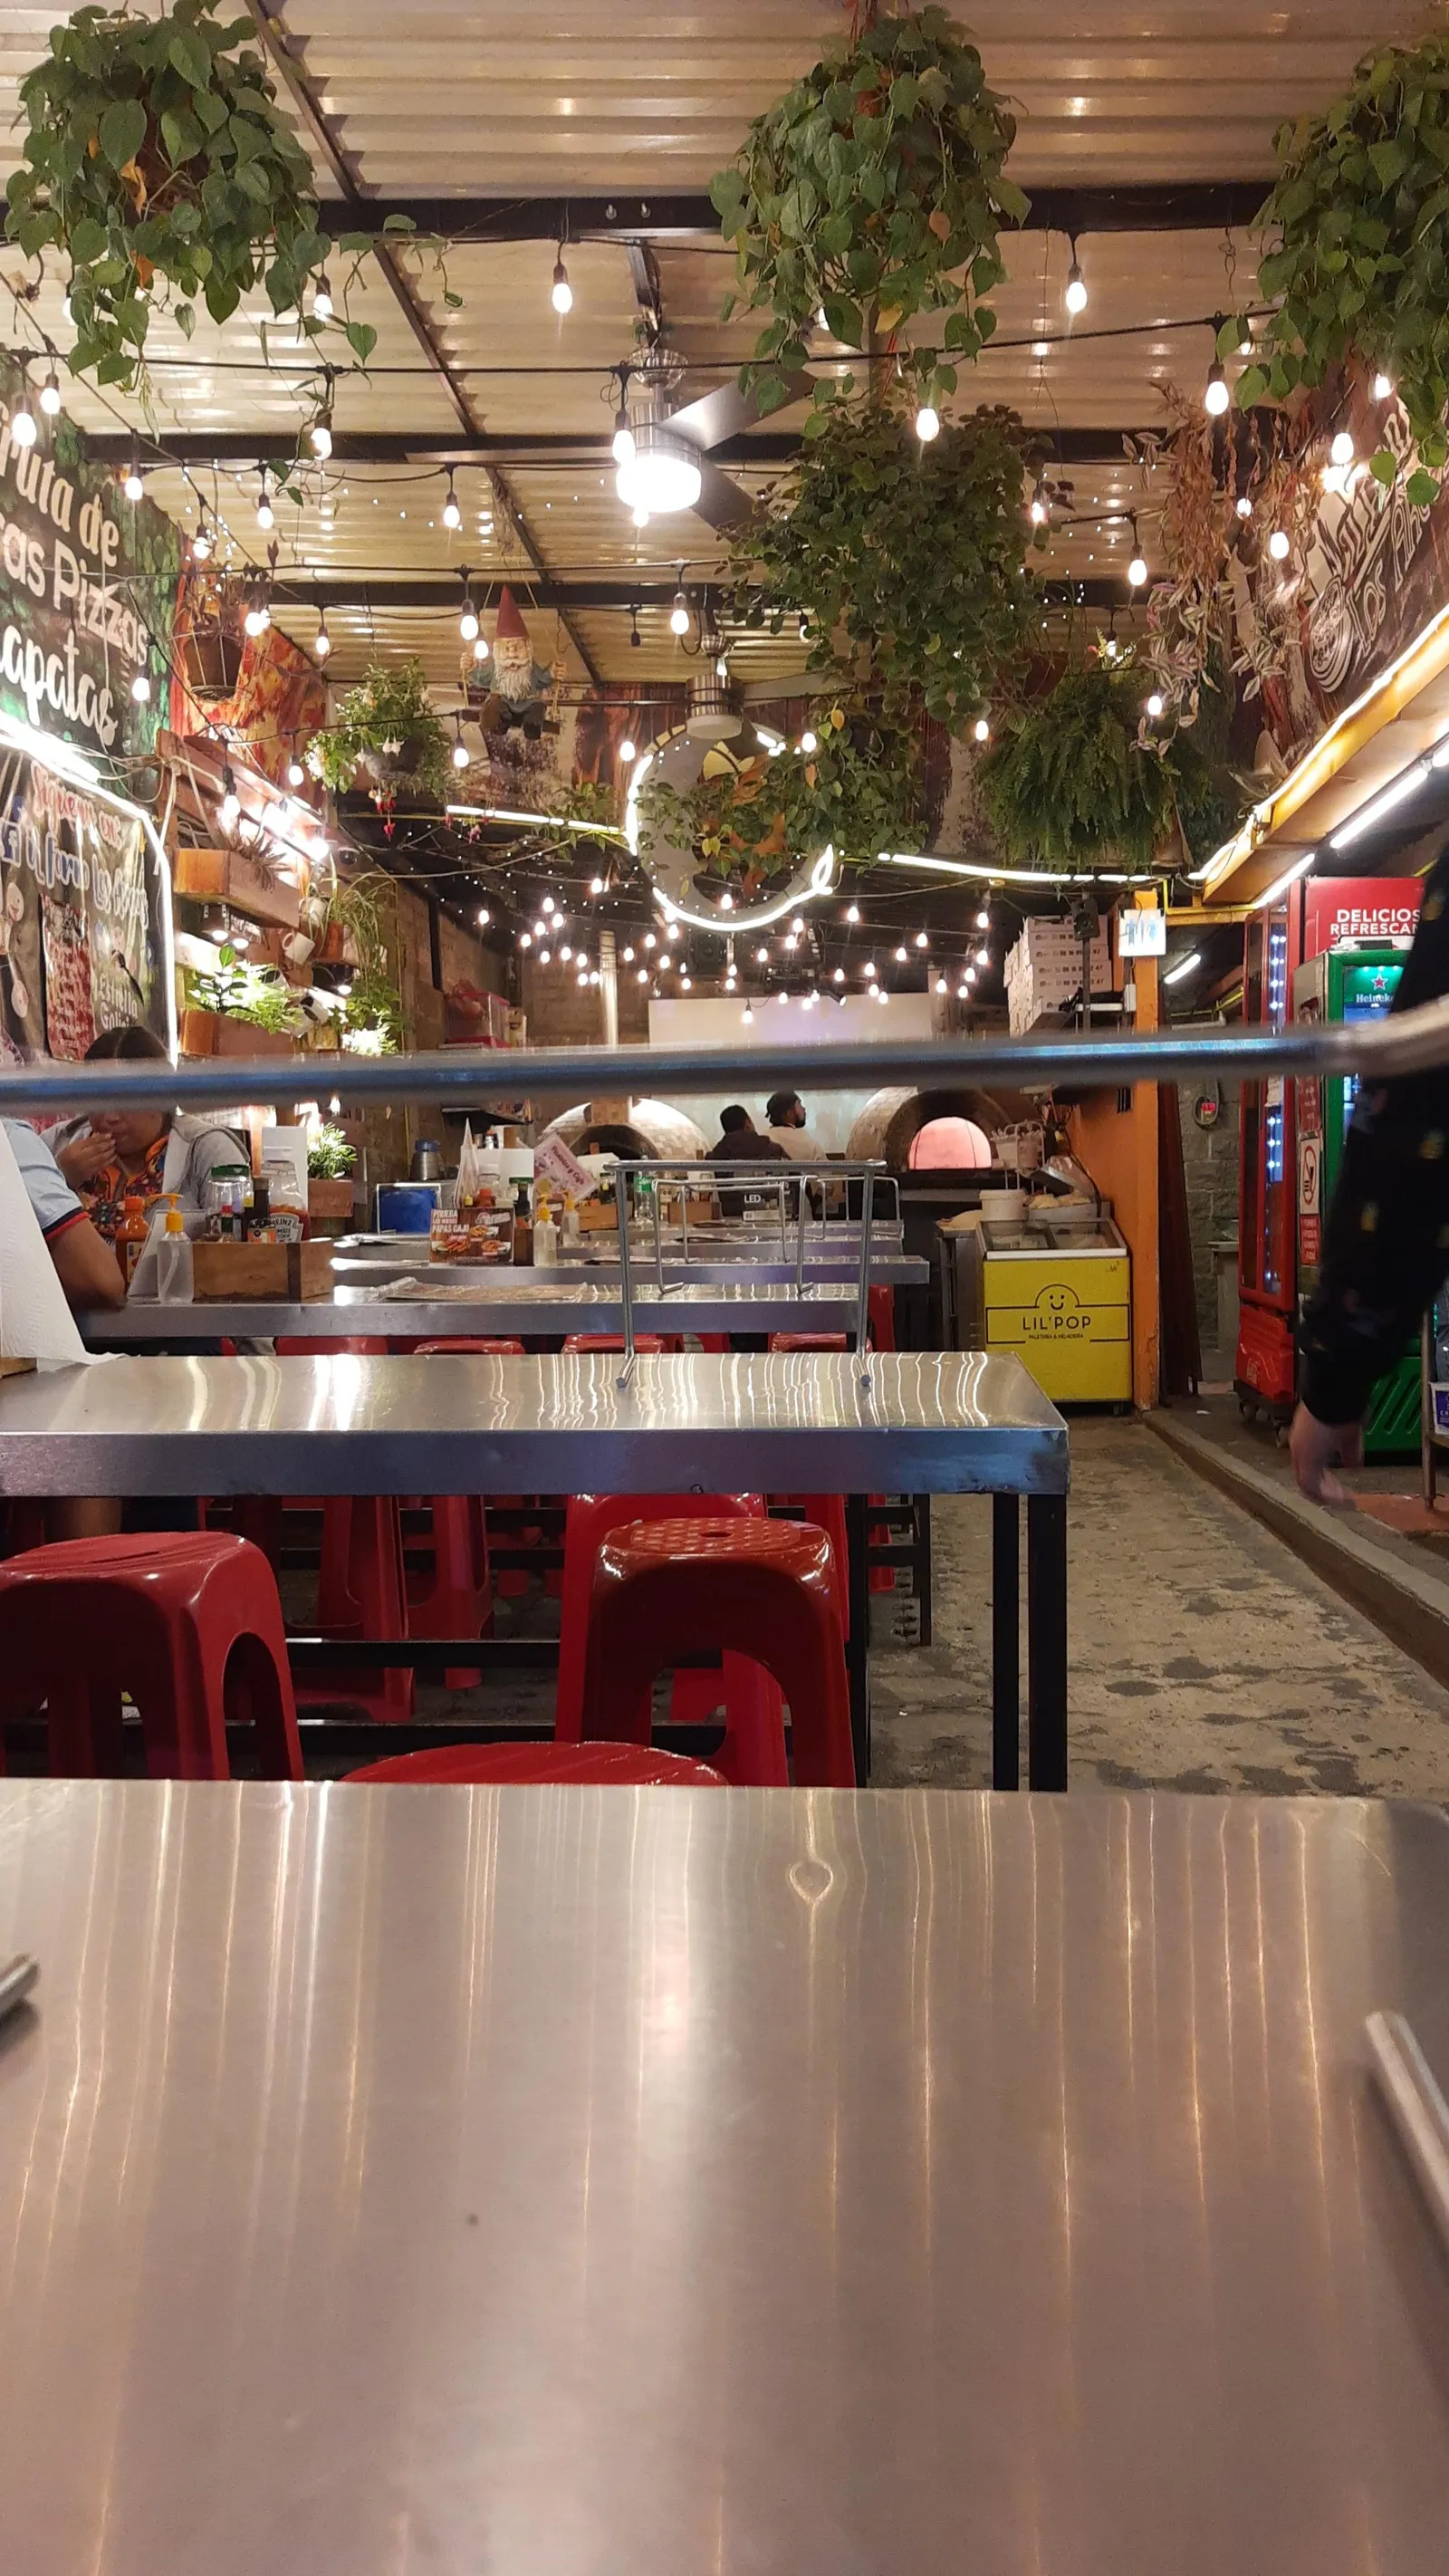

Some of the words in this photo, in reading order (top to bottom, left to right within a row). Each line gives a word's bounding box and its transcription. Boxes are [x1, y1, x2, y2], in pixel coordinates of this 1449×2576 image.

[0, 401, 74, 533] ruta
[80, 493, 119, 566] de
[0, 513, 44, 596] as
[53, 538, 148, 666] Pizzas
[0, 625, 118, 746] apatas
[744, 1194, 762, 1204] LED
[1022, 1316, 1090, 1330] LIL'POP
